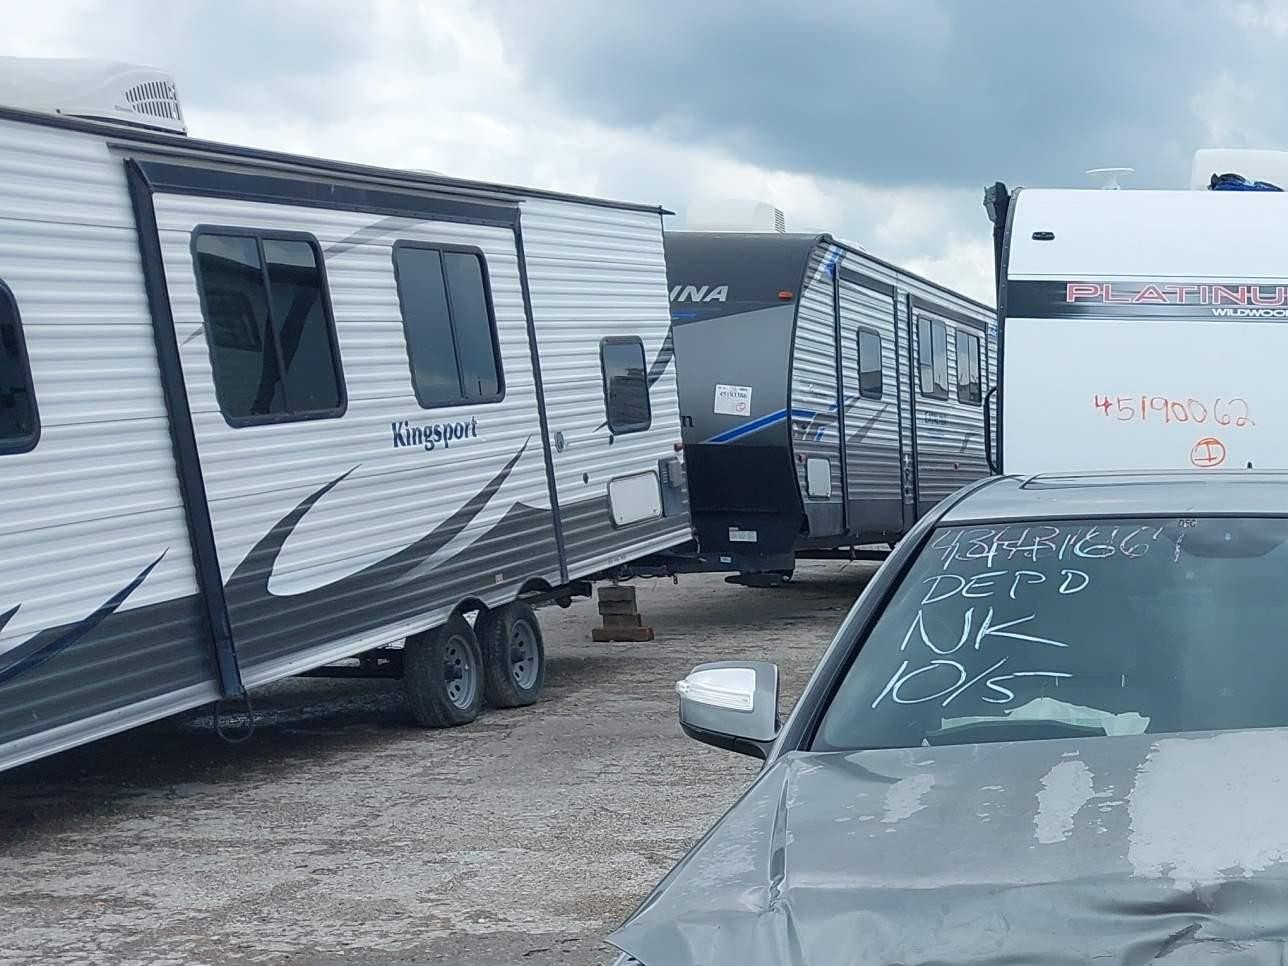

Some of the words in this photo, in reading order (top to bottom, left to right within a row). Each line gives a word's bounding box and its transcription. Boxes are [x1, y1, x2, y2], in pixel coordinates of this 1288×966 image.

[1094, 394, 1256, 427] 45190062
[391, 415, 478, 451] Kingsport
[901, 607, 1069, 654] NK
